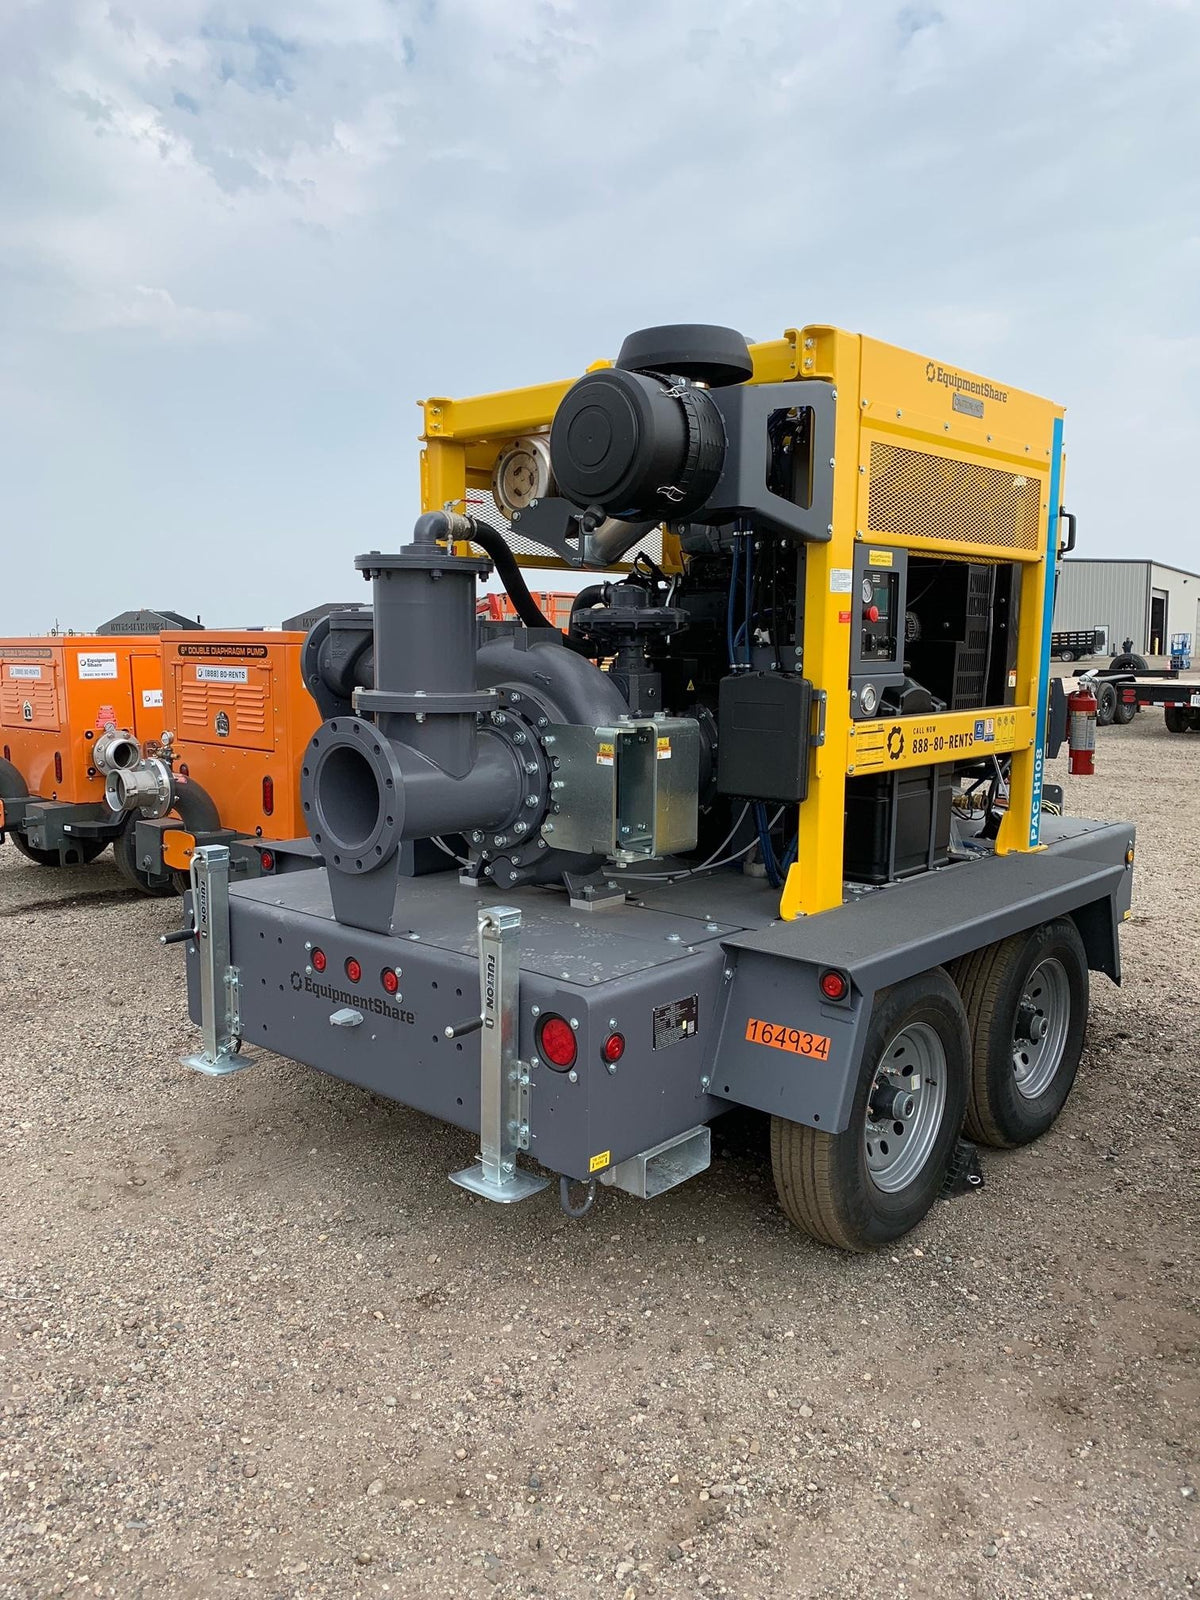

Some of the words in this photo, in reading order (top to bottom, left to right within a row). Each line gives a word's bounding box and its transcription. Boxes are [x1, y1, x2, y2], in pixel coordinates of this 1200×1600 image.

[937, 366, 1008, 403] EquipmentShare
[188, 646, 210, 655] DOUBLE
[210, 647, 246, 656] DIAPHRAGM
[246, 648, 265, 656] PUMP
[205, 669, 219, 678] (888)
[219, 670, 246, 679] 80-RENTS
[912, 727, 925, 735] CALL
[926, 725, 937, 733] NOW
[912, 732, 974, 754] 888-80-RENTS
[1033, 748, 1043, 795] H108
[1030, 800, 1040, 841] PAC
[304, 976, 415, 1025] EquipmentShare
[486, 954, 496, 1010] FULTON
[750, 1020, 828, 1059] 164934
